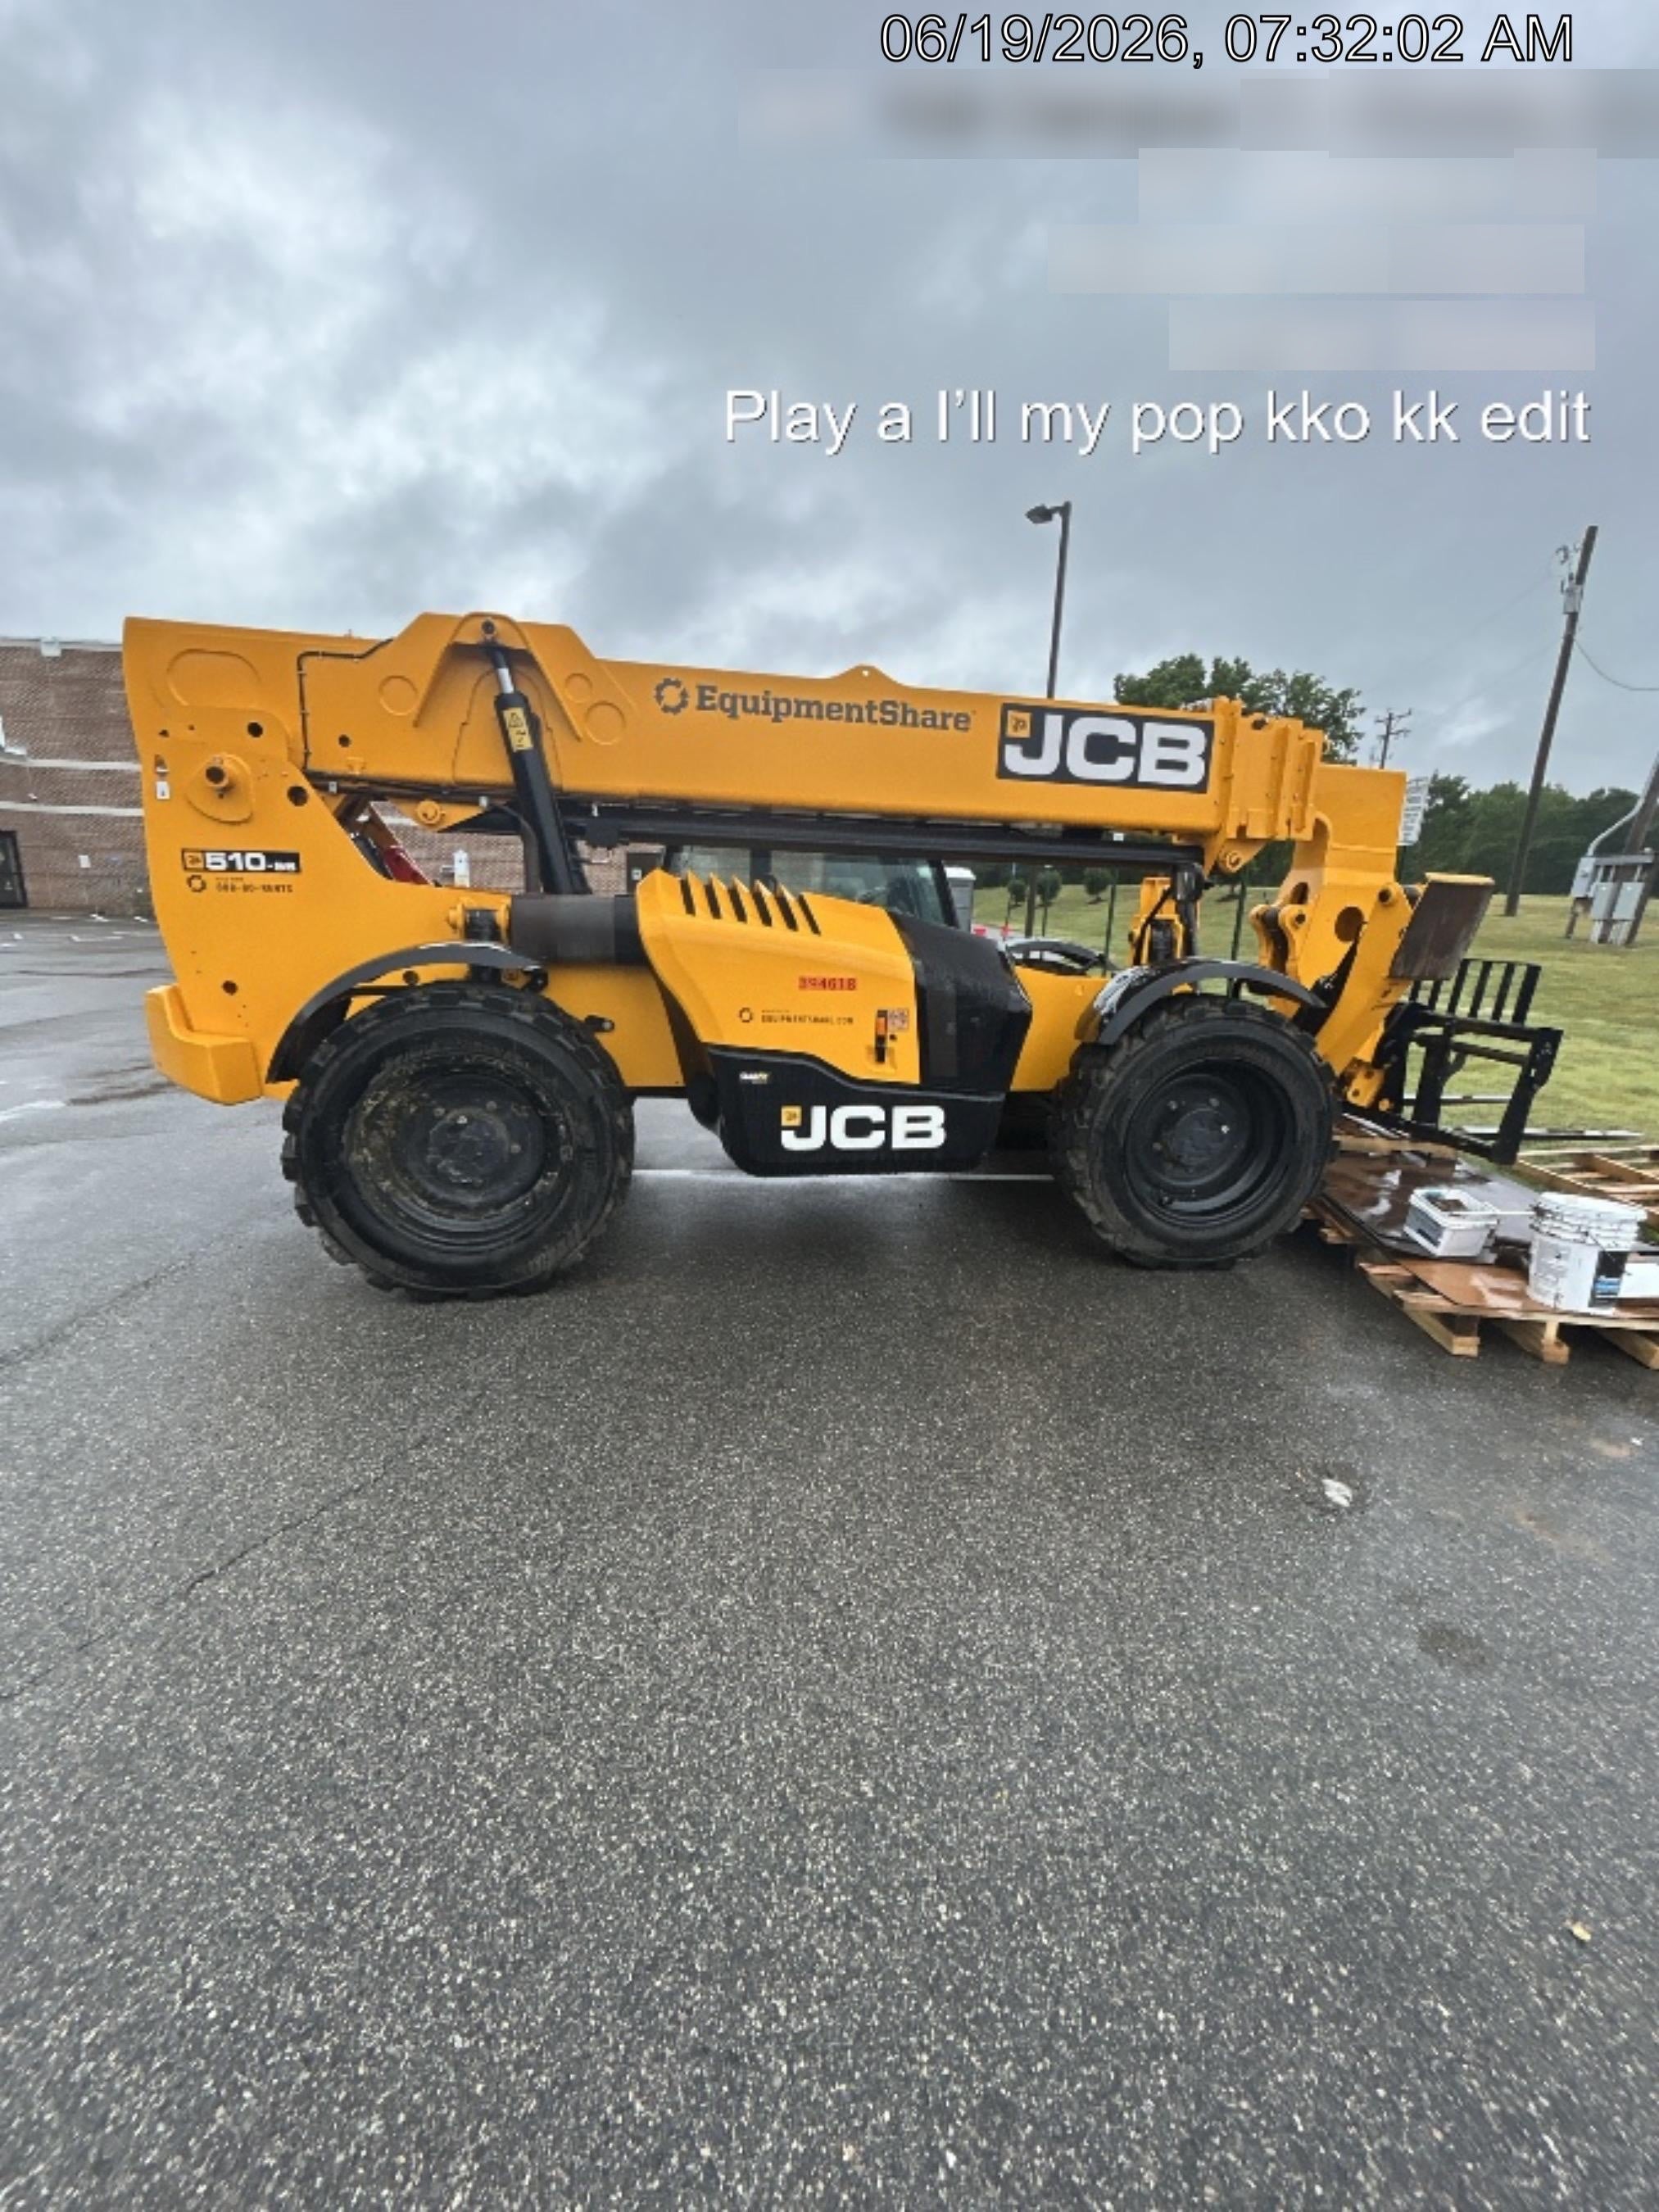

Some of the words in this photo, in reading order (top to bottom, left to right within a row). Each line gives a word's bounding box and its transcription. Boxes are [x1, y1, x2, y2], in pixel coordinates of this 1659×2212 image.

[695, 684, 973, 732] EquipmentShare
[1004, 714, 1208, 786] JCB
[781, 1105, 946, 1151] JCB
